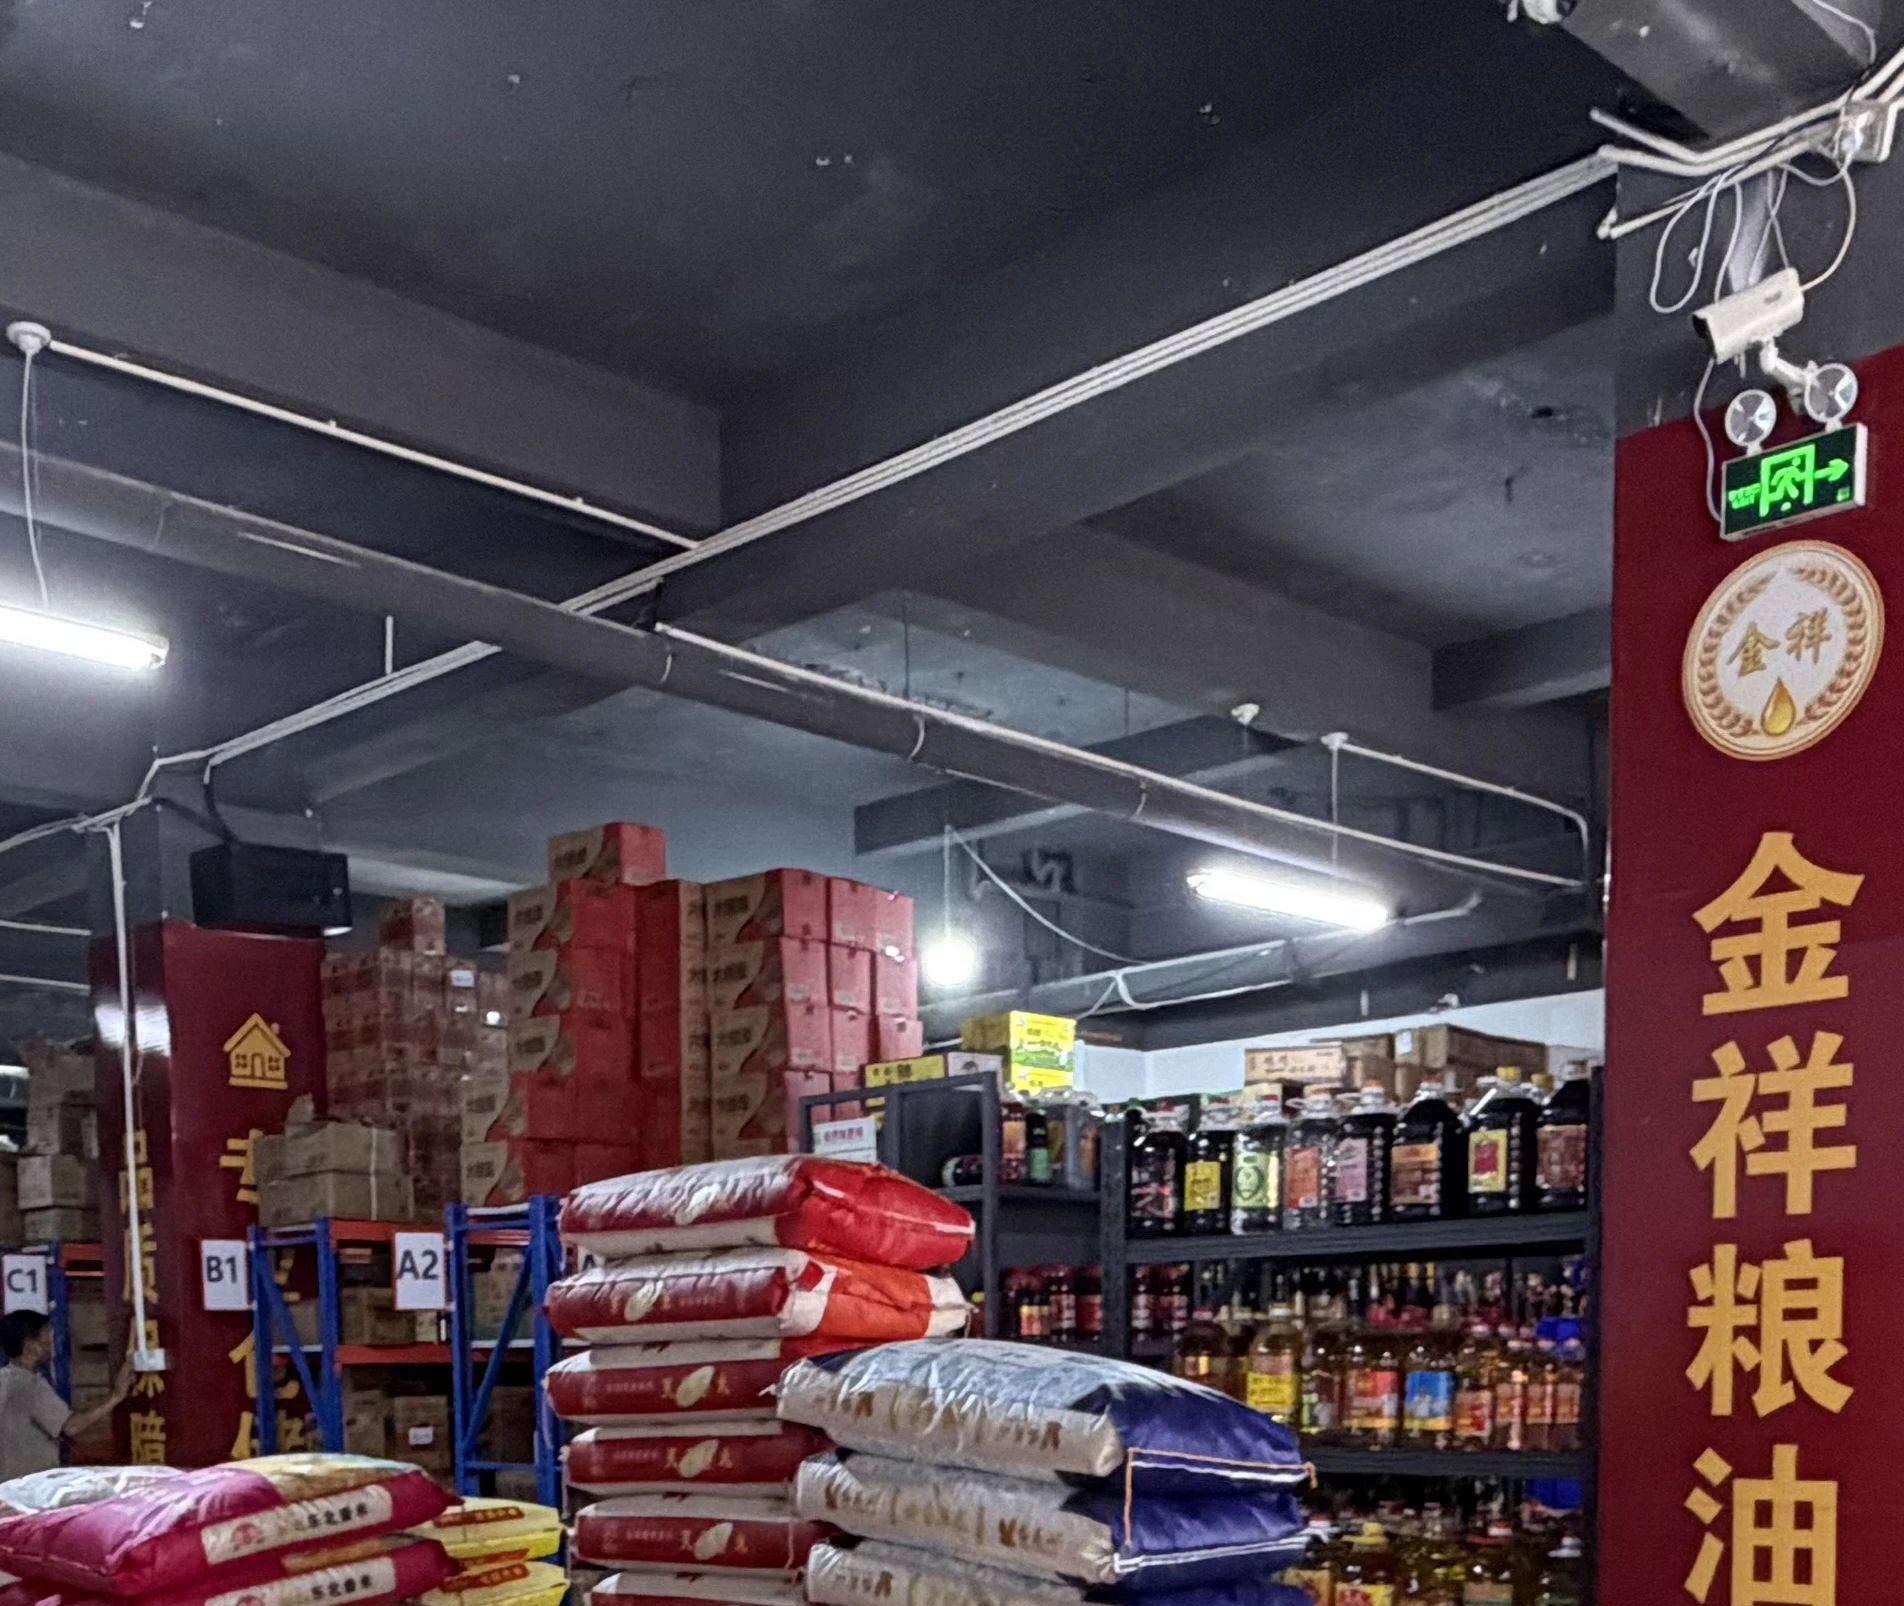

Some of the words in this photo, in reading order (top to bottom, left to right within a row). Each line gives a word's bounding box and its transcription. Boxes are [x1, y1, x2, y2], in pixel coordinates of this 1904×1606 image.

[1728, 607, 1832, 677] 金祥
[206, 1256, 237, 1284] B1
[396, 1251, 440, 1279] A2
[7, 1269, 38, 1293] C1
[306, 1503, 369, 1531] 东北香米
[310, 1573, 374, 1602] 东北香米
